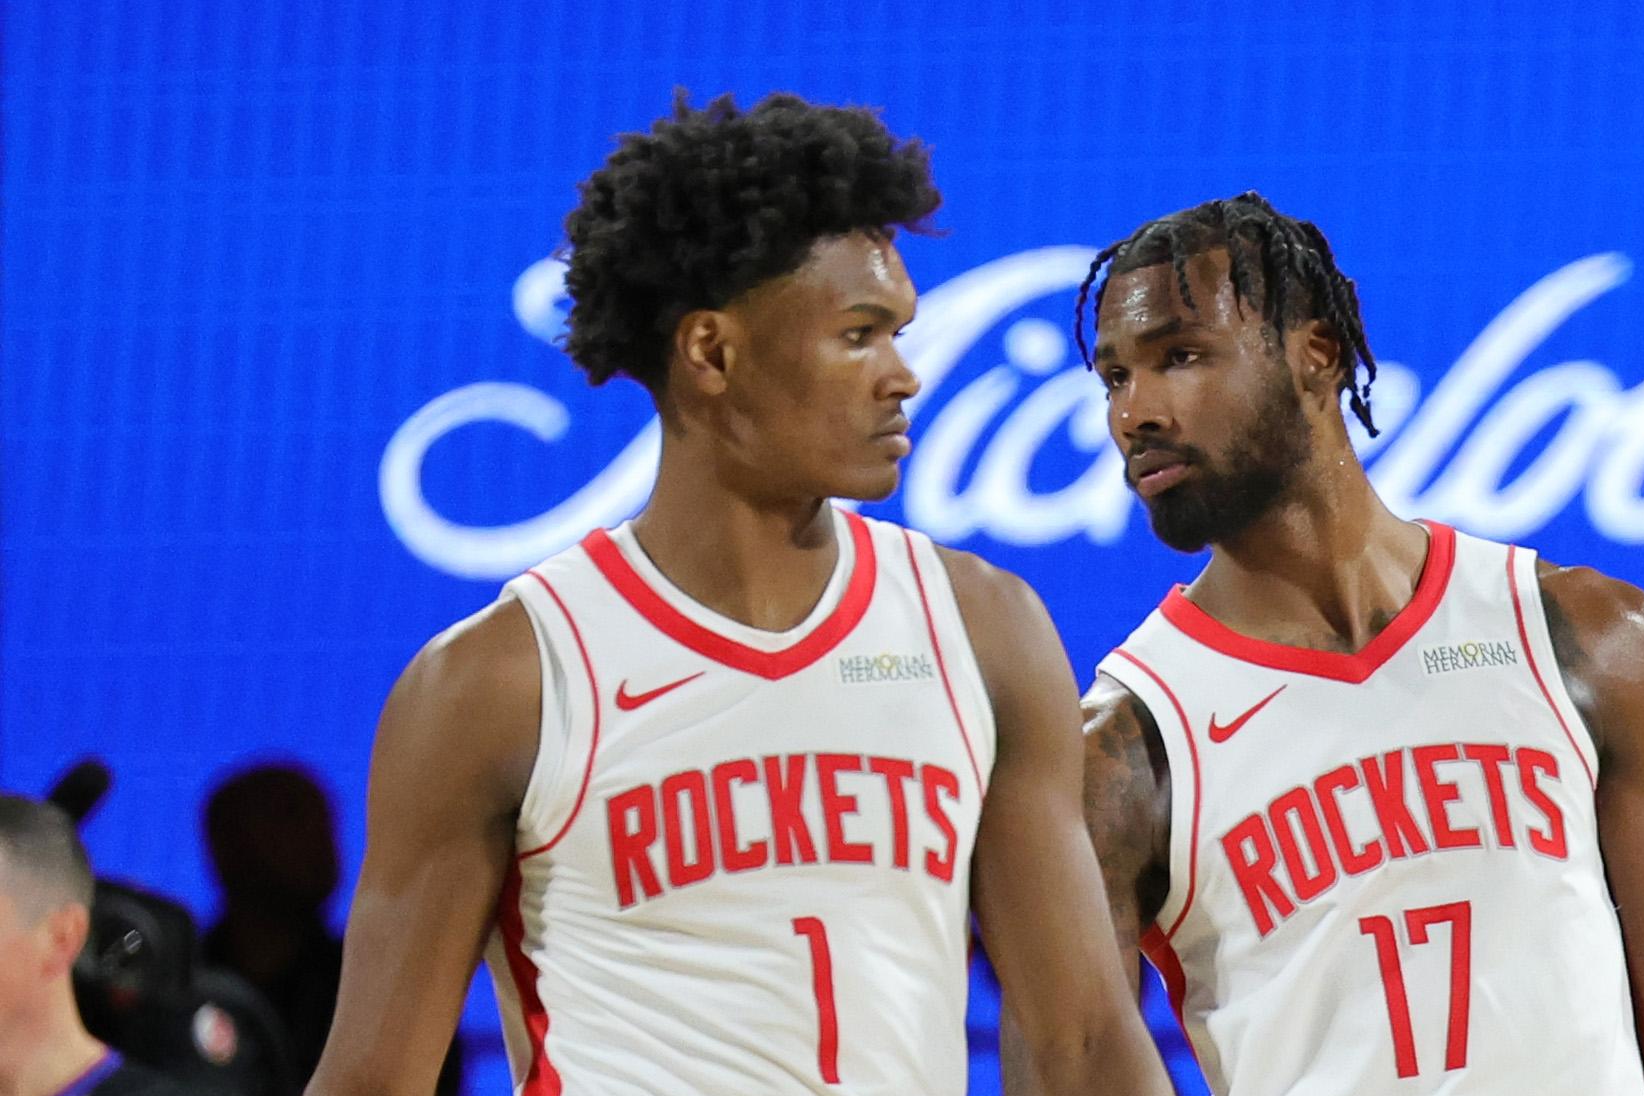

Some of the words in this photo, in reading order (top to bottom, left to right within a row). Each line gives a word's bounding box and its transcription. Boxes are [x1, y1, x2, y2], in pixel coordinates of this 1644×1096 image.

[1423, 641, 1516, 662] MEMORIAL
[1424, 651, 1518, 674] HERMANN
[605, 752, 961, 911] ROCKETS
[1218, 742, 1569, 941] ROCKETS
[791, 916, 841, 1084] 1
[1358, 900, 1472, 1079] 17
